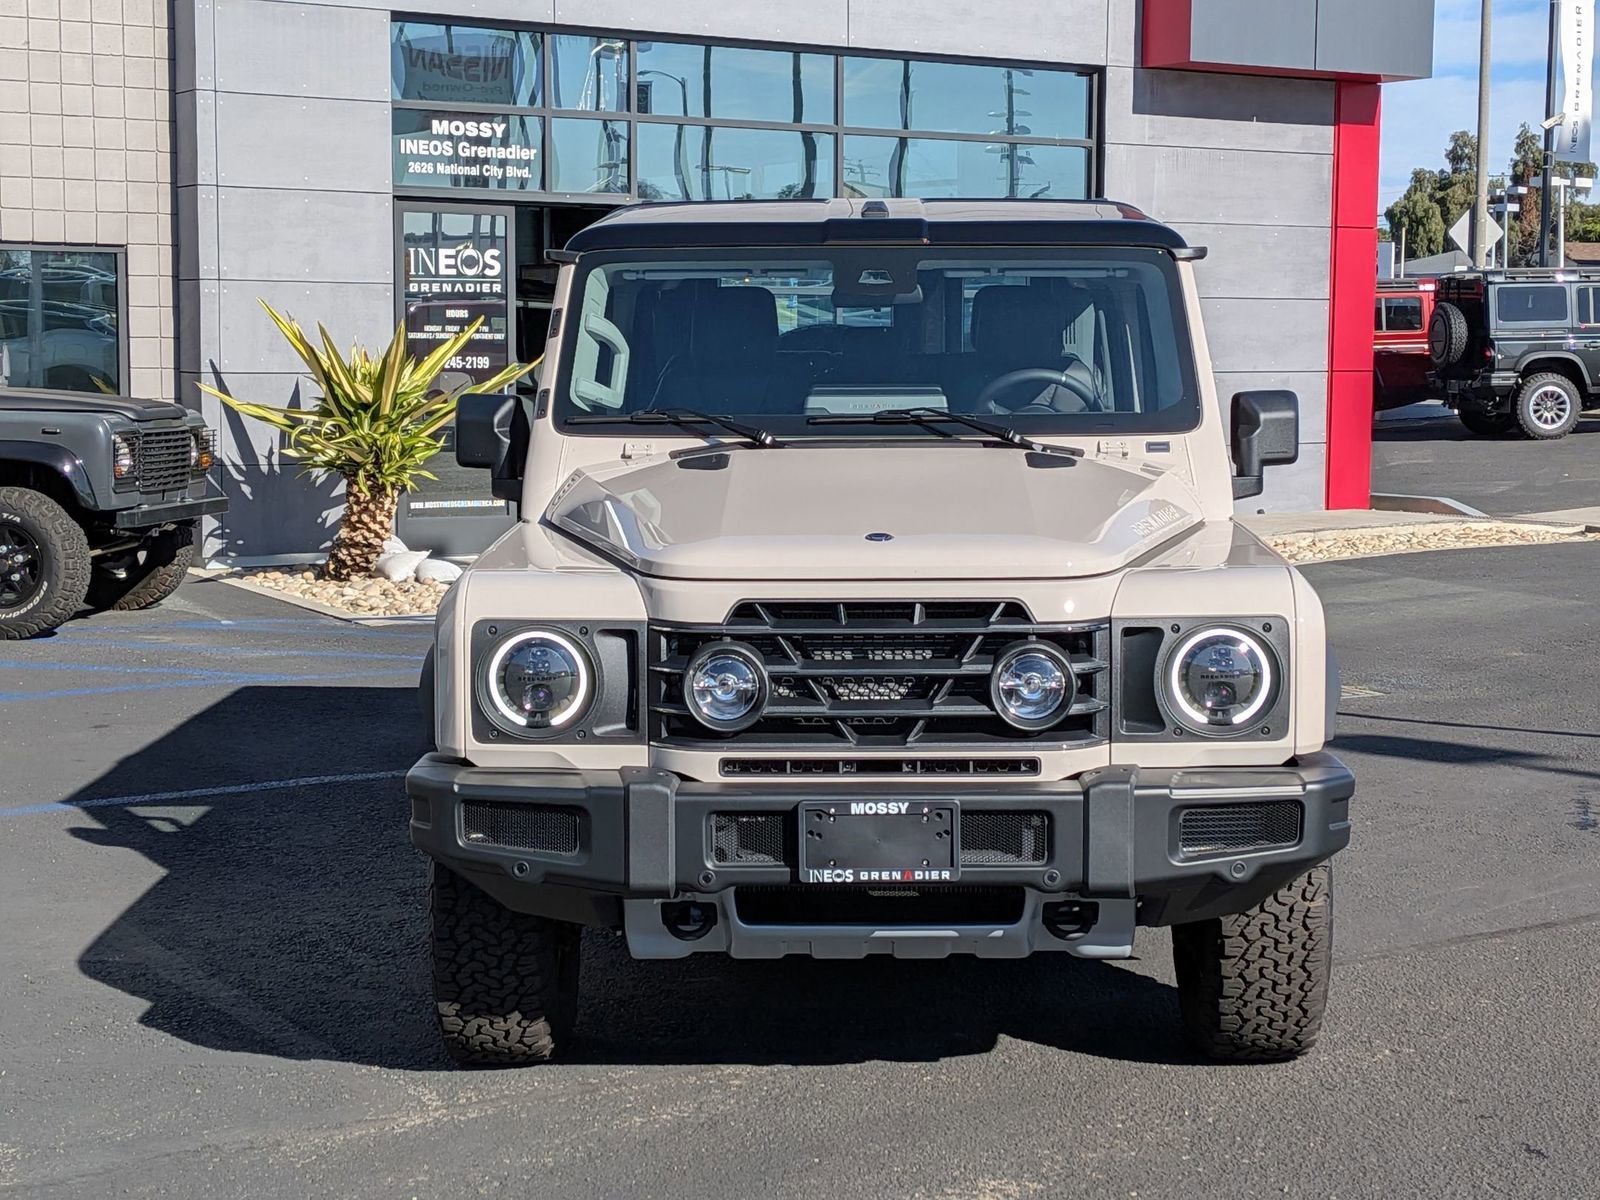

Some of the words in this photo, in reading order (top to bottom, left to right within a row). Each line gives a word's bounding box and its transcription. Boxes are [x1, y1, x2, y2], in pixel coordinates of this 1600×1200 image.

[1569, 120, 1579, 154] INEOS
[1574, 5, 1583, 112] GRENADIER
[432, 120, 506, 138] MOSSY
[400, 139, 453, 156] INEOS
[458, 142, 537, 160] Grenadier
[408, 162, 434, 174] 2626
[436, 163, 480, 176] National
[482, 165, 503, 179] City
[506, 165, 532, 178] Blvd.
[408, 247, 501, 276] INEOS
[409, 282, 502, 293] GRENADIER
[1, 512, 21, 523] T/A
[0, 580, 48, 620] BFGoodri
[851, 802, 909, 815] MOSSY
[809, 869, 854, 883] INEOS
[860, 870, 950, 881] GRENADIER
